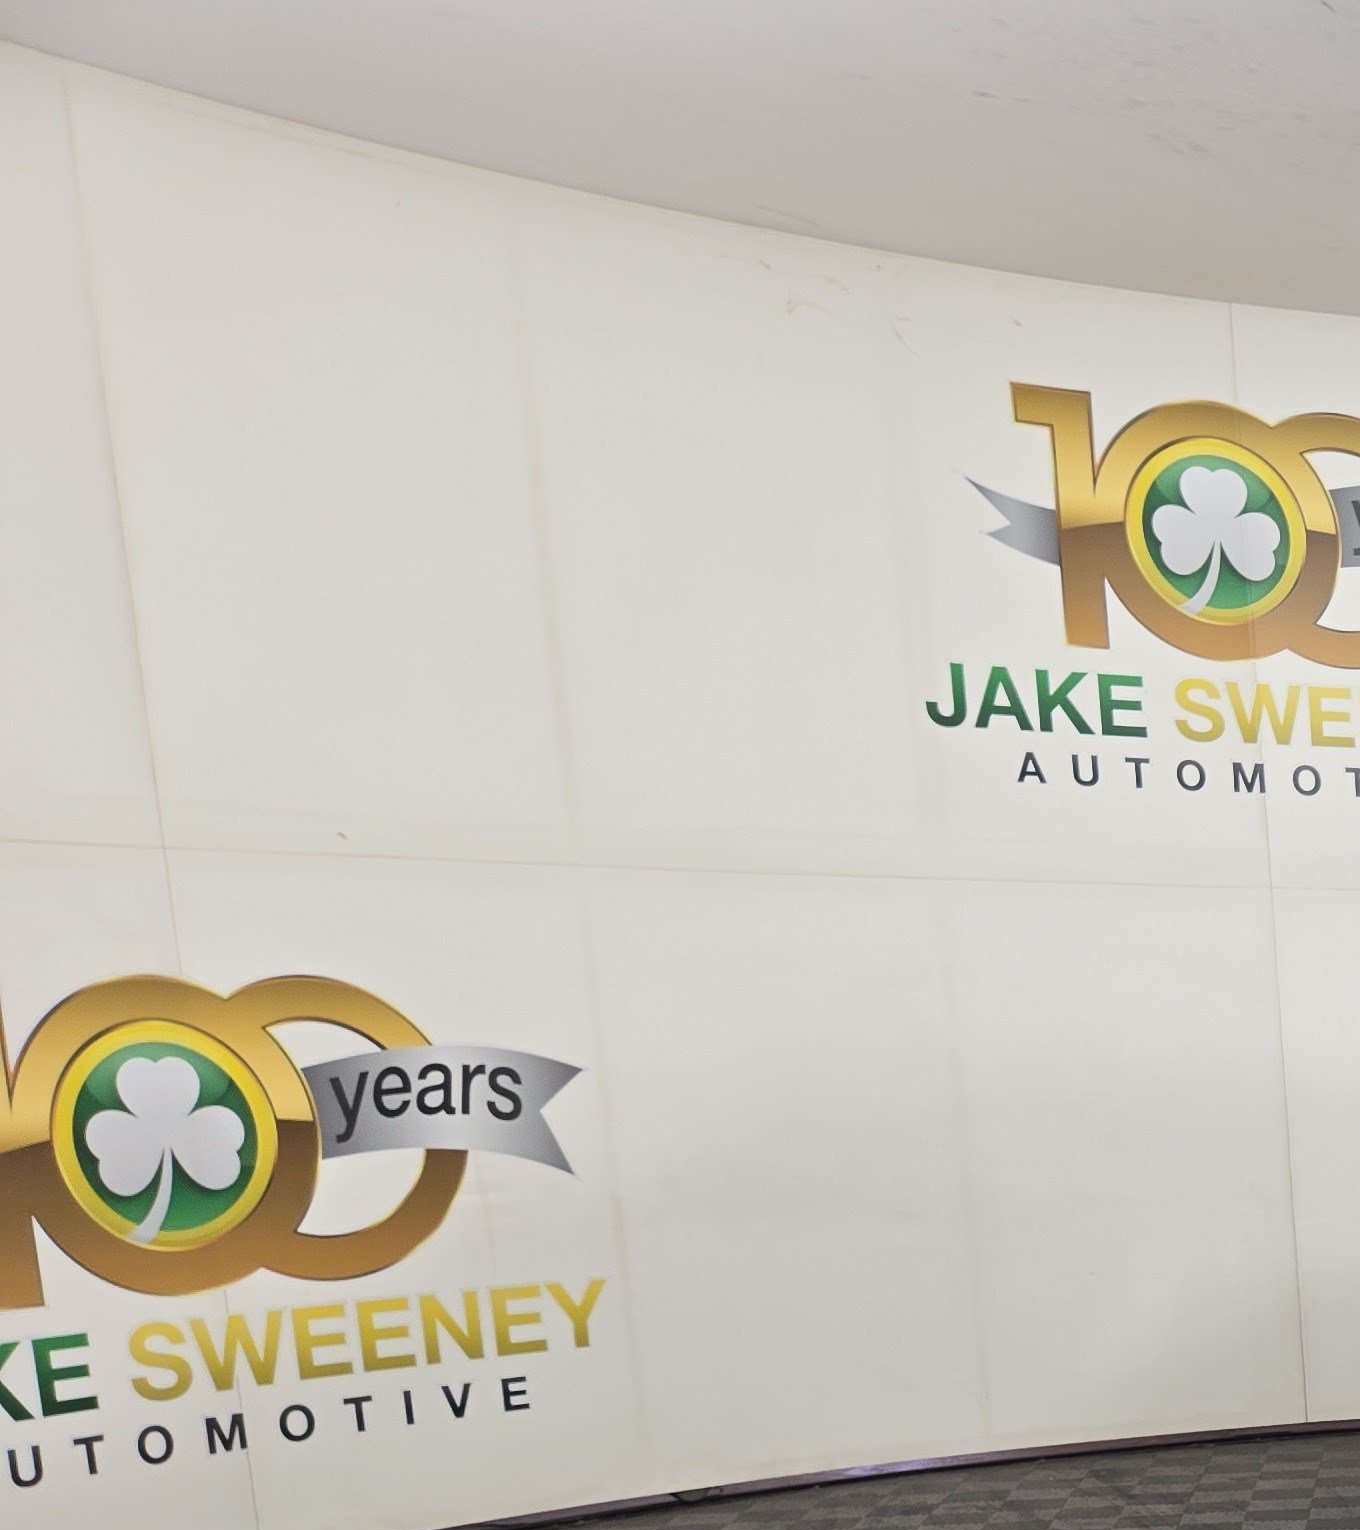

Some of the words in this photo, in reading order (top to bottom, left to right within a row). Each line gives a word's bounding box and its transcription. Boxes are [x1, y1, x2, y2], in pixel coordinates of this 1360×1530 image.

[925, 662, 1148, 739] JAKE
[329, 1060, 523, 1144] years
[127, 1278, 606, 1403] SWEENEY
[8, 1376, 531, 1488] UTOMOTIVE
